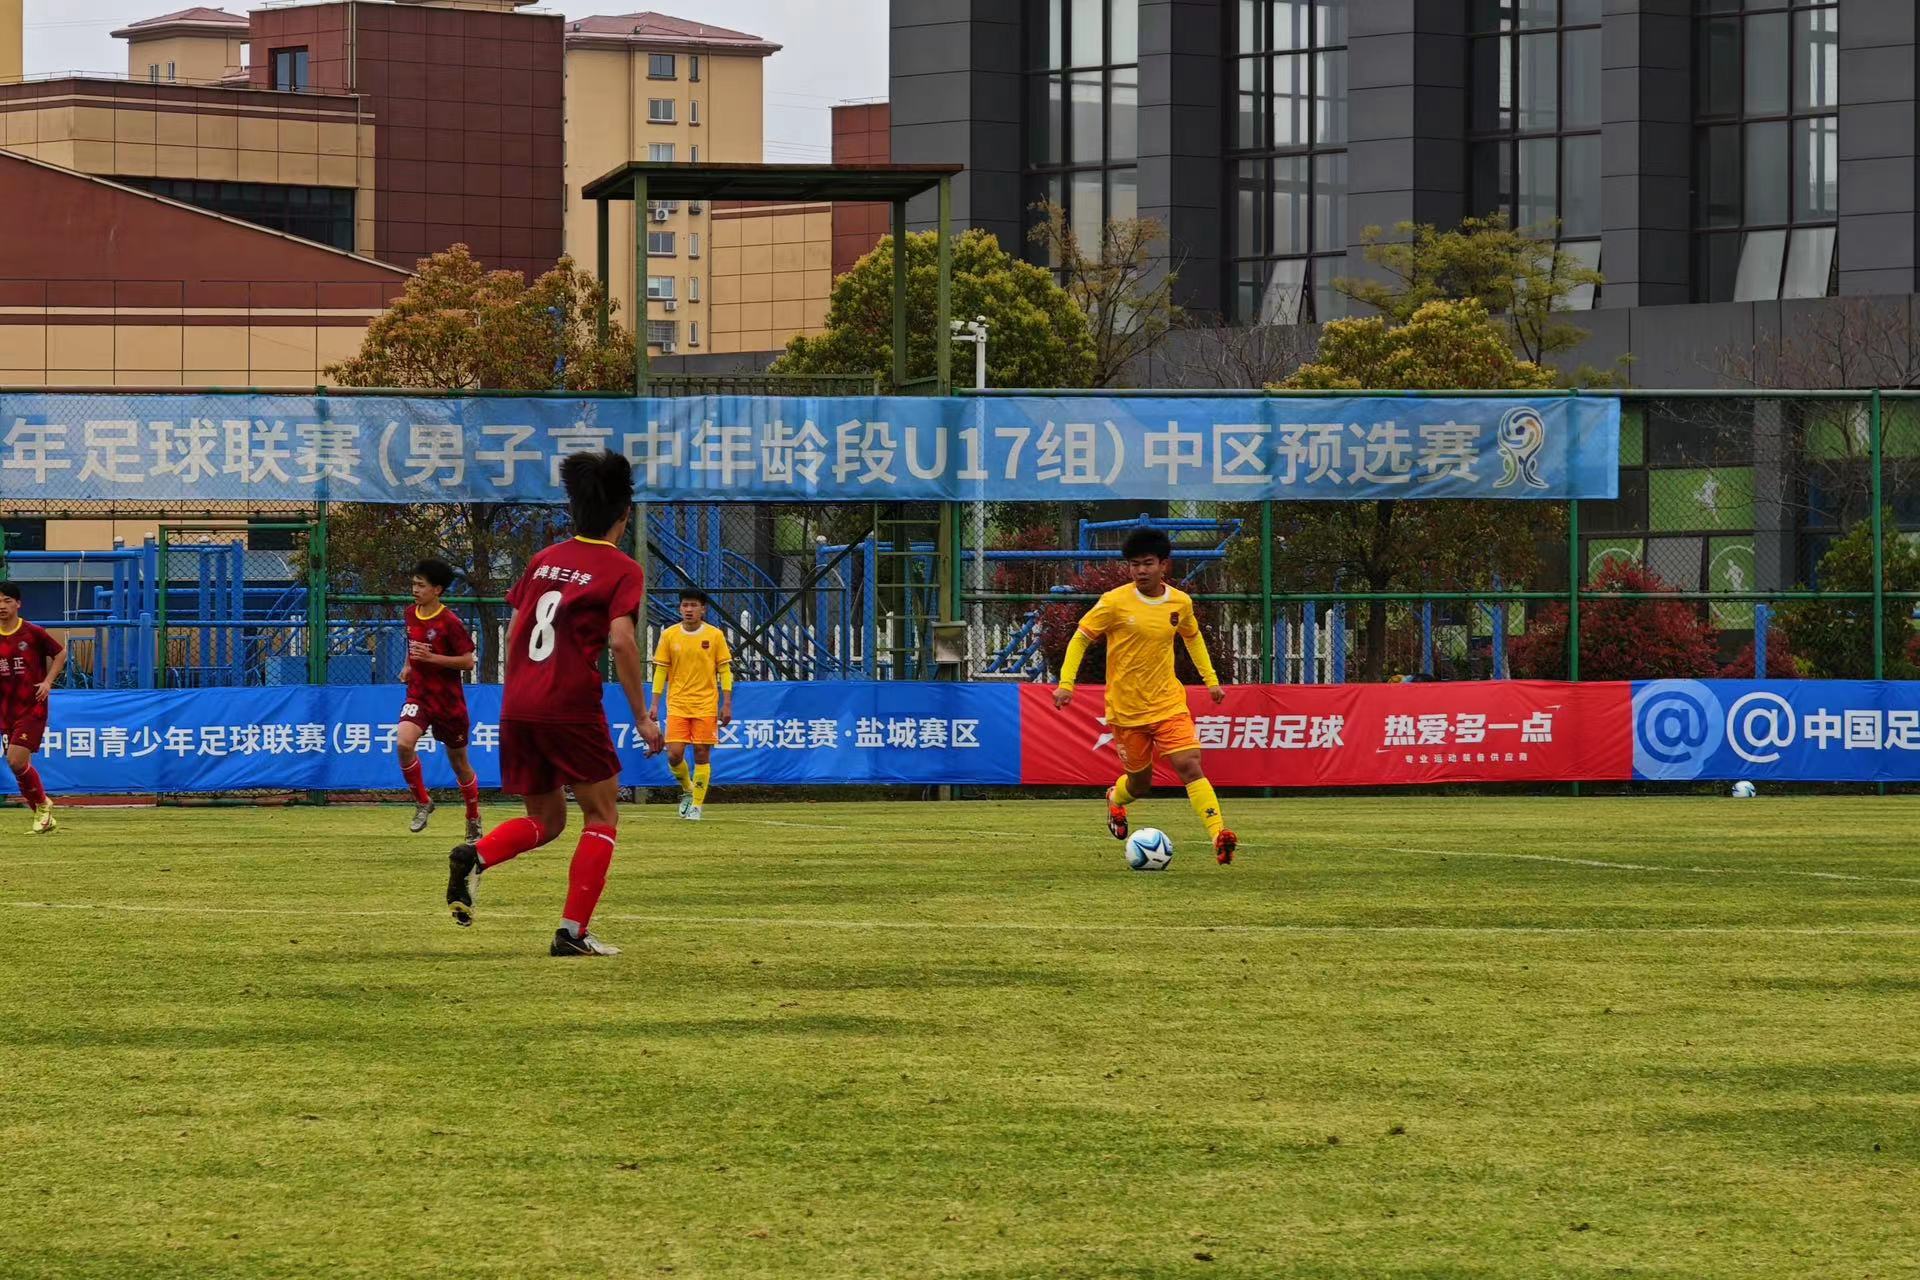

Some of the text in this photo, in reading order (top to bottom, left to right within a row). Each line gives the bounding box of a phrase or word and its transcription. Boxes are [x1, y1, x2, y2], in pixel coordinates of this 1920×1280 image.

[529, 590, 562, 662] 8
[1194, 714, 1345, 749] 茵浪足球
[1383, 711, 1553, 746] 热爱·多一点
